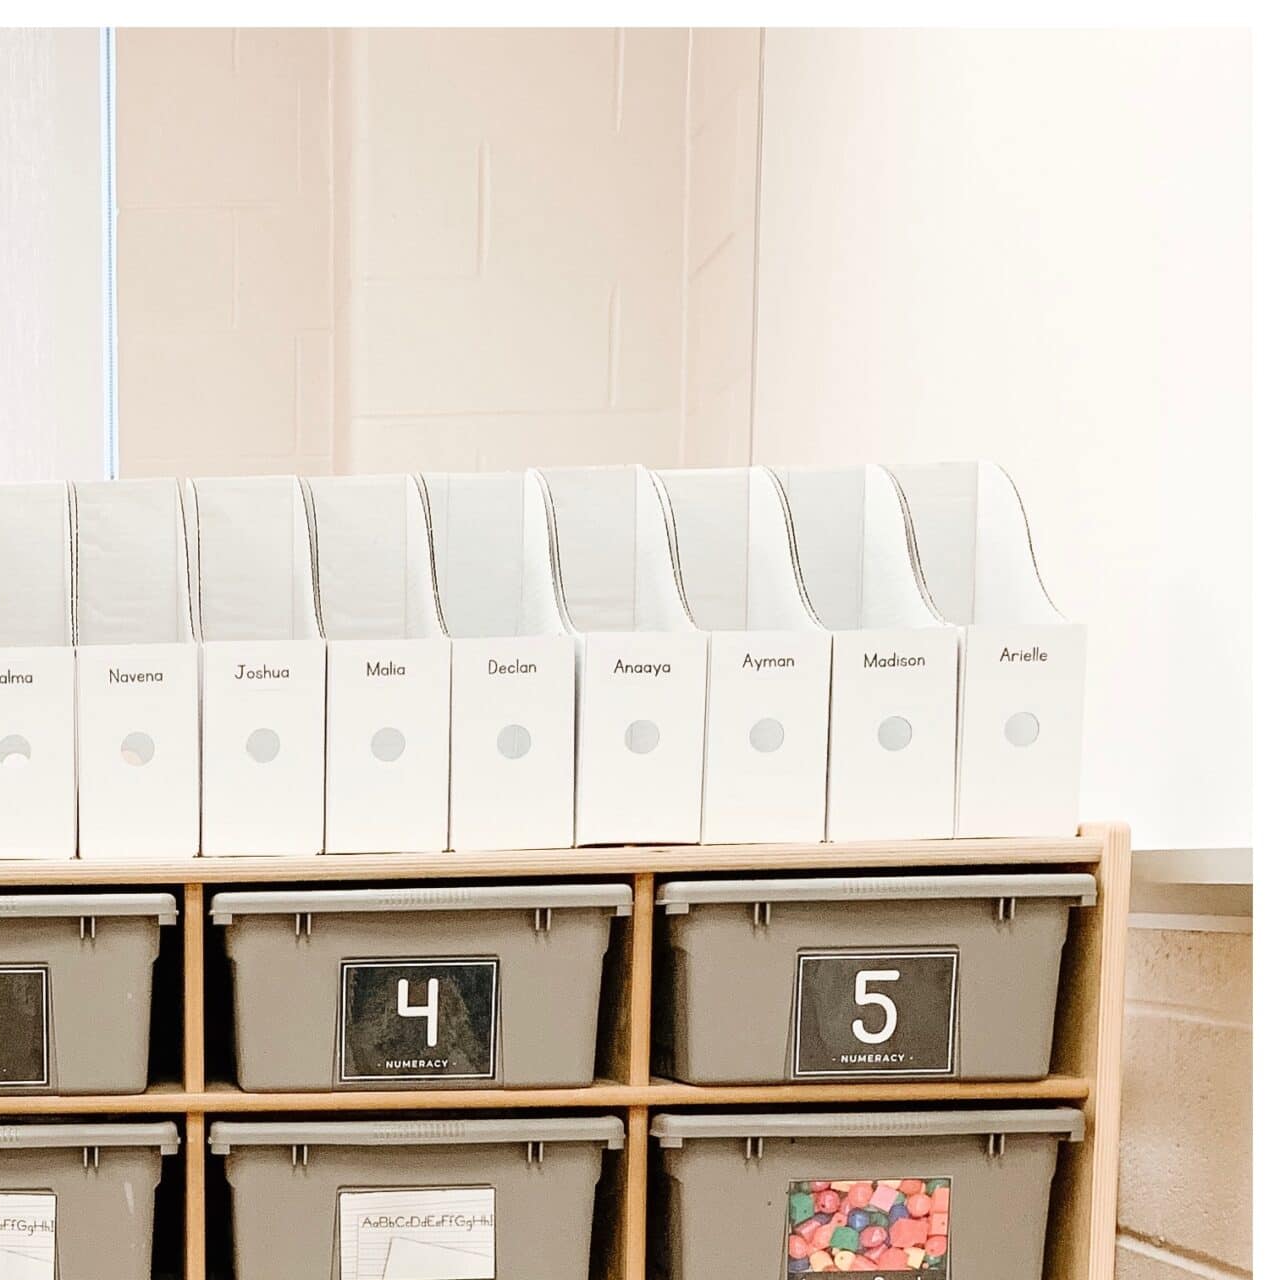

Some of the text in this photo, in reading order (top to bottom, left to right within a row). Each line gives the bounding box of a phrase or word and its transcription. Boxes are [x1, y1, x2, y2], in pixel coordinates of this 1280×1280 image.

[863, 652, 926, 668] Madison
[999, 646, 1048, 662] Arielle
[366, 661, 406, 677] Malia
[488, 658, 537, 675] Declan
[613, 658, 671, 677] Anaaya
[742, 653, 795, 672] Ayman
[109, 668, 163, 684] Navena
[234, 663, 290, 680] Joshua
[397, 978, 439, 1047] 4
[852, 969, 900, 1044] 5
[385, 1058, 448, 1070] NUMERACY
[840, 1052, 905, 1064] NUMERACY
